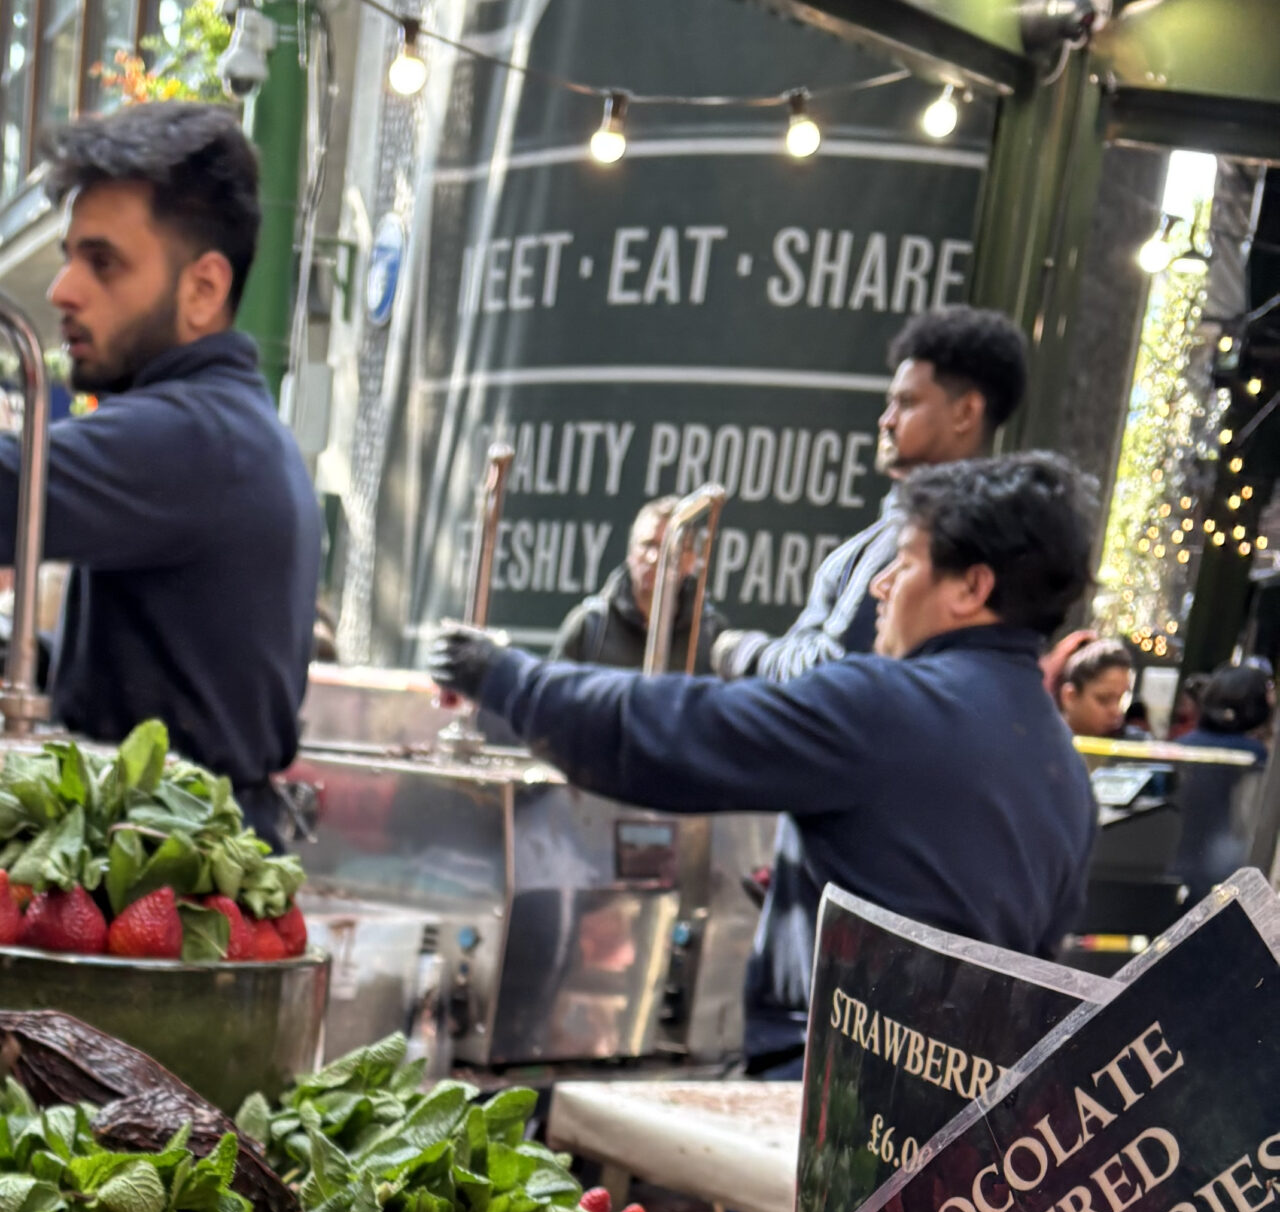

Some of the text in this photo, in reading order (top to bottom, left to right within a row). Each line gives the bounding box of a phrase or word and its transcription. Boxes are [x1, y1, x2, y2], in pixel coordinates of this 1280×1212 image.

[607, 226, 728, 305] EAT
[767, 226, 973, 313] SHARE
[472, 421, 874, 508] ALITY PRODUCE
[458, 520, 612, 594] FESHLY
[867, 1113, 920, 1174] £6.0
